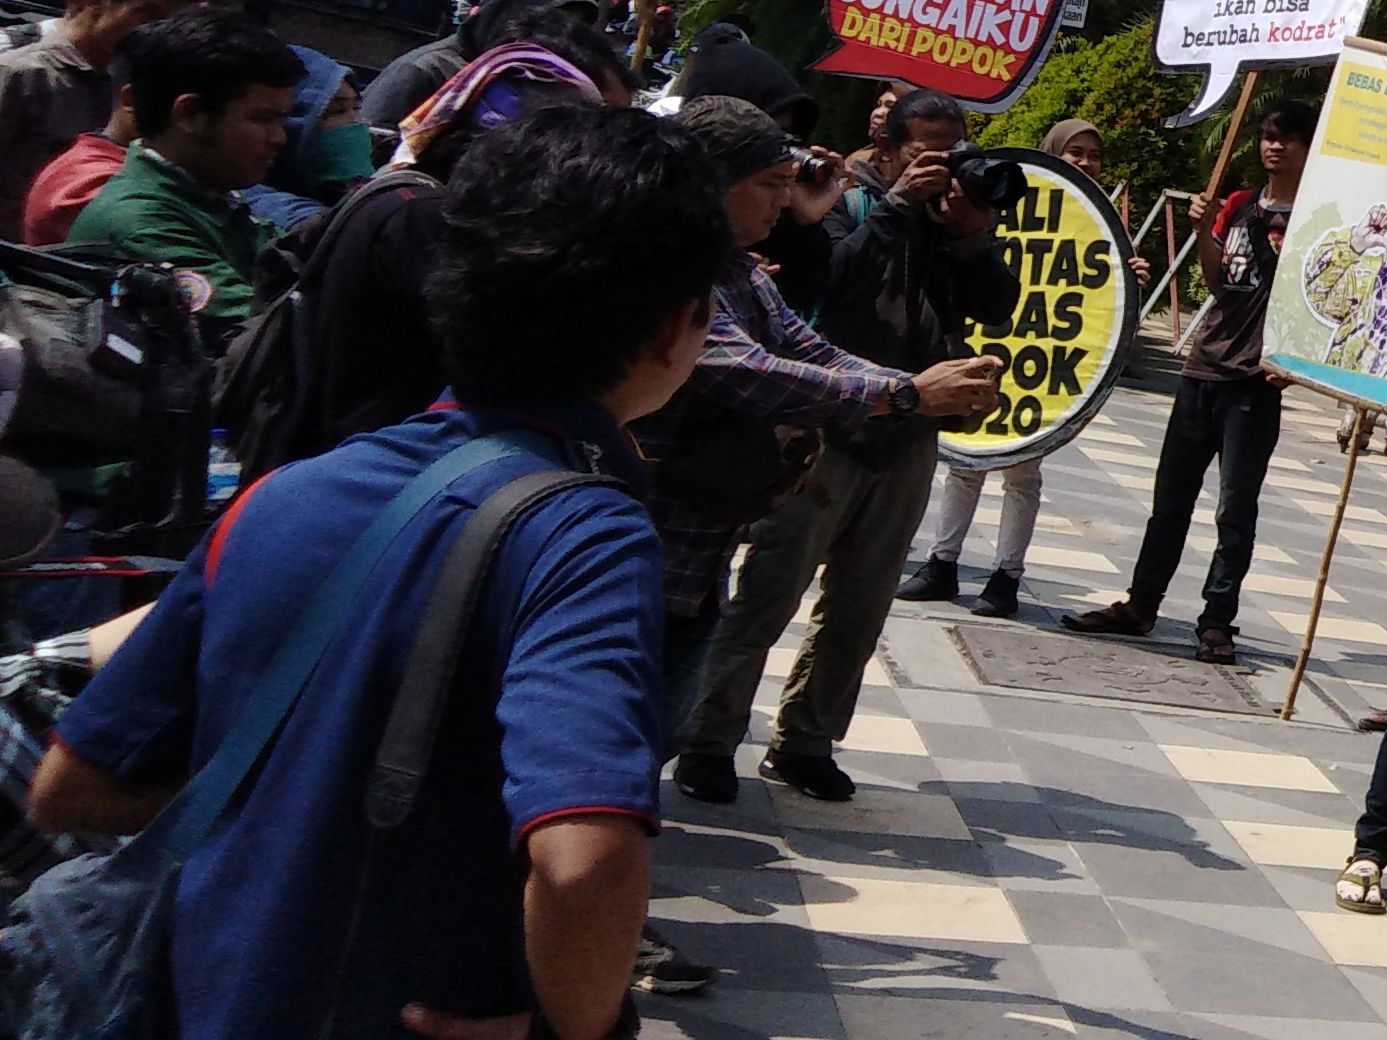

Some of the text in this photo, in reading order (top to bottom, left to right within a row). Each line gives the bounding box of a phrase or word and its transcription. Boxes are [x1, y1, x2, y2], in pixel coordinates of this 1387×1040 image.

[911, 25, 1018, 82] POPOK
[1181, 24, 1260, 48] berubah
[1346, 71, 1383, 93] BEBAS
[995, 186, 1065, 233] ALI
